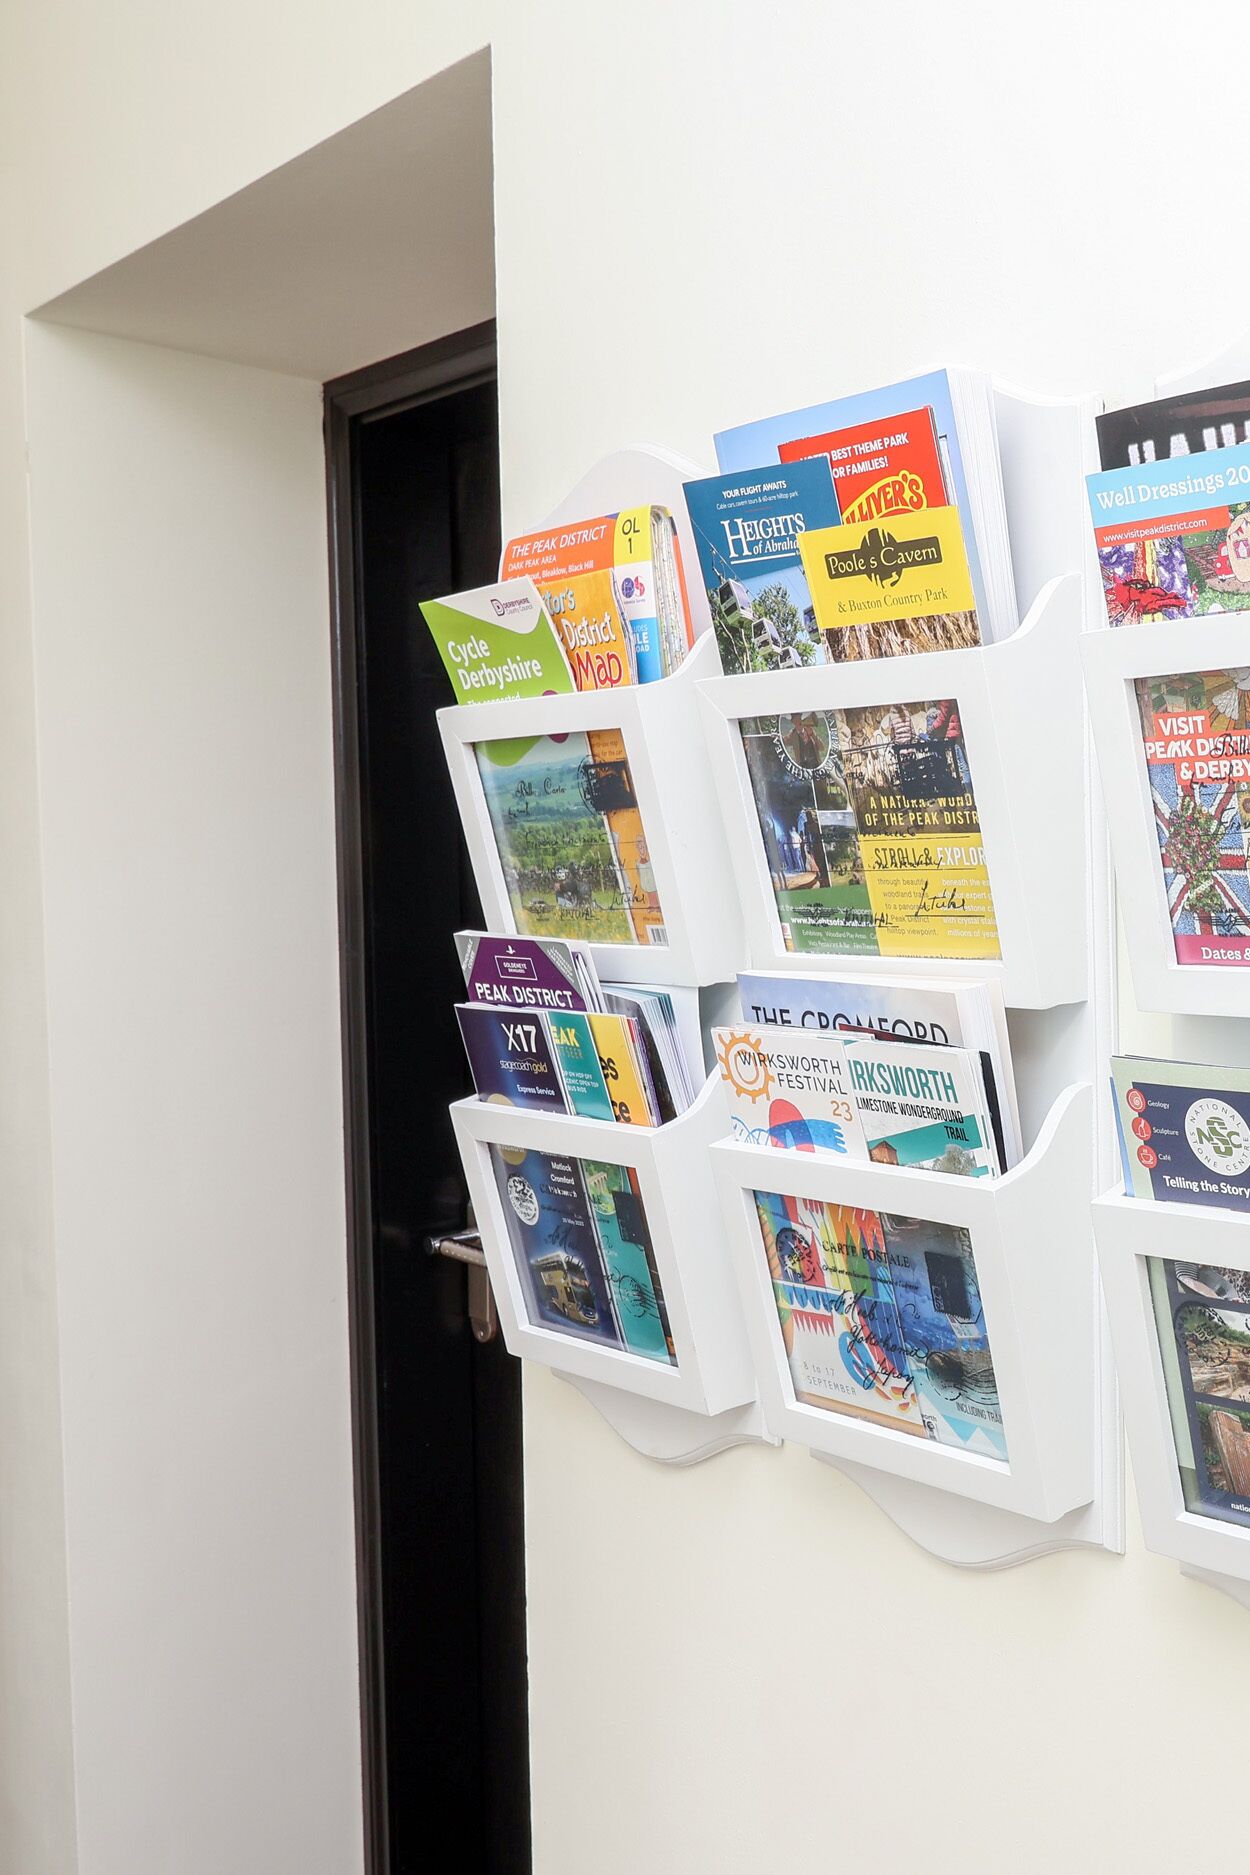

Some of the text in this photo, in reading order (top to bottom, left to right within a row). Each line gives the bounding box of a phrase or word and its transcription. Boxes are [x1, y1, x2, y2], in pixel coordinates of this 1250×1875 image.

[832, 447, 852, 461] BEST
[854, 439, 882, 456] THEME
[884, 433, 909, 449] PARK
[847, 456, 889, 476] FAMILIES!
[1097, 483, 1136, 511] Well
[1137, 475, 1224, 504] Dressings
[512, 524, 608, 558] THE PEAK DISTRICT
[721, 512, 805, 558] HEIGHTS
[1103, 518, 1208, 543] www.visitpeakdistrict.com
[508, 554, 557, 571] DARK PEAK AREA
[881, 545, 938, 566] Cavern
[838, 587, 948, 613] & Buxton Country Park
[565, 612, 616, 650] District
[448, 636, 490, 666] Cycle
[458, 656, 543, 690] Derbyshire
[576, 650, 622, 691] Map
[1158, 715, 1205, 736] VISIT
[1147, 741, 1196, 759] PEAK
[1180, 764, 1193, 780] &
[865, 810, 979, 826] OF THE PEAK DISTR
[878, 878, 901, 887] through
[942, 878, 968, 886] beneath
[891, 916, 905, 924] Peak
[1201, 947, 1242, 961] Dates
[475, 982, 573, 1008] PEAK DISTRICT
[501, 1023, 537, 1053] X17
[499, 1059, 548, 1075] stagecoach gold
[737, 1050, 842, 1075] WIRKSWORTH
[516, 1084, 555, 1096] Express Service
[777, 1073, 848, 1095] FESTIVAL
[848, 1060, 959, 1104] IRKSWORTH
[830, 1100, 853, 1122] 23
[856, 1096, 964, 1124] LIMESTONE WONDERGROUND
[944, 1126, 969, 1142] TRAIL
[551, 1162, 573, 1172] Matlock
[551, 1174, 574, 1185] Cromford
[1163, 1175, 1199, 1192] Telling
[1200, 1180, 1219, 1192] the
[1220, 1182, 1250, 1198] Story
[808, 1375, 857, 1396] SEPTEMBER
[956, 1402, 987, 1420] INCLUDING
